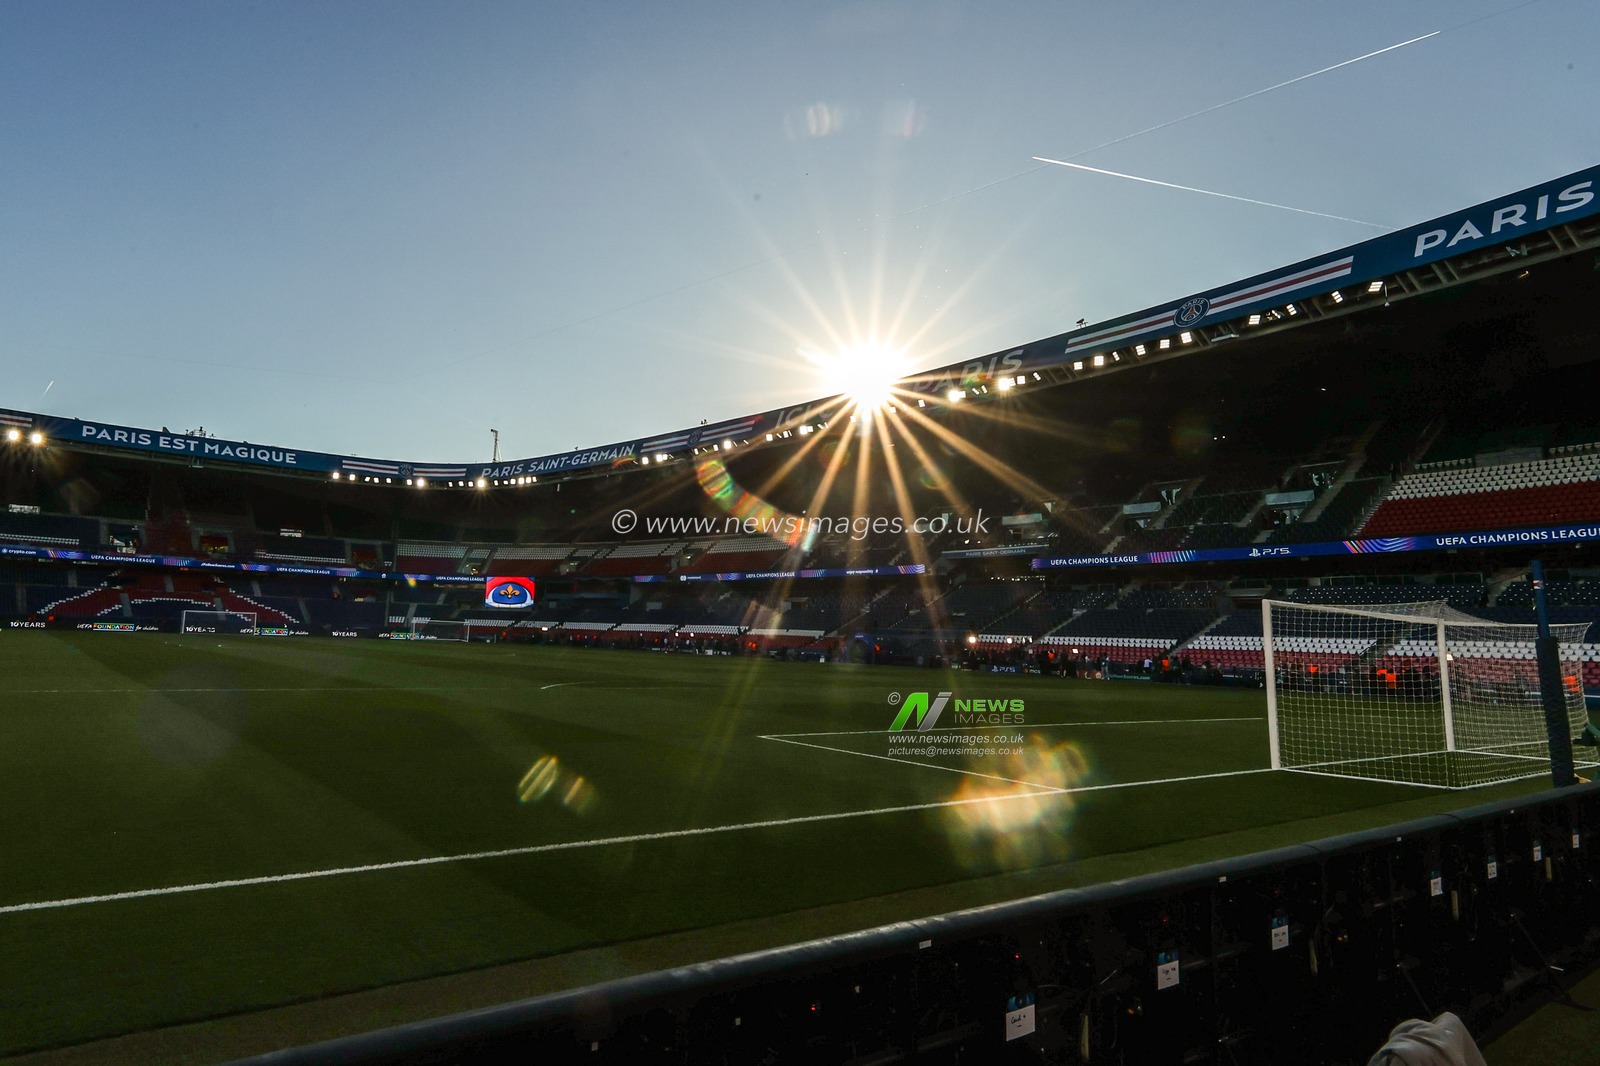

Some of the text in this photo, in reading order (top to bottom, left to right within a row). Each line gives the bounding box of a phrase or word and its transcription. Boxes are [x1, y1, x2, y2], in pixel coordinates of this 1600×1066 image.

[1414, 181, 1595, 258] PARIS
[82, 425, 297, 464] PARIS EST MAGIQUE
[481, 444, 635, 478] PARIS SAINT-GERMAIN
[1435, 527, 1600, 546] UEFA CHAMPIONS LEAGU
[105, 555, 136, 563] CHAMPIONS
[1262, 547, 1290, 556] PS5
[1050, 555, 1138, 566] UEFA CHAMPIONS LEAGUE
[93, 623, 135, 631] FOUNDATION
